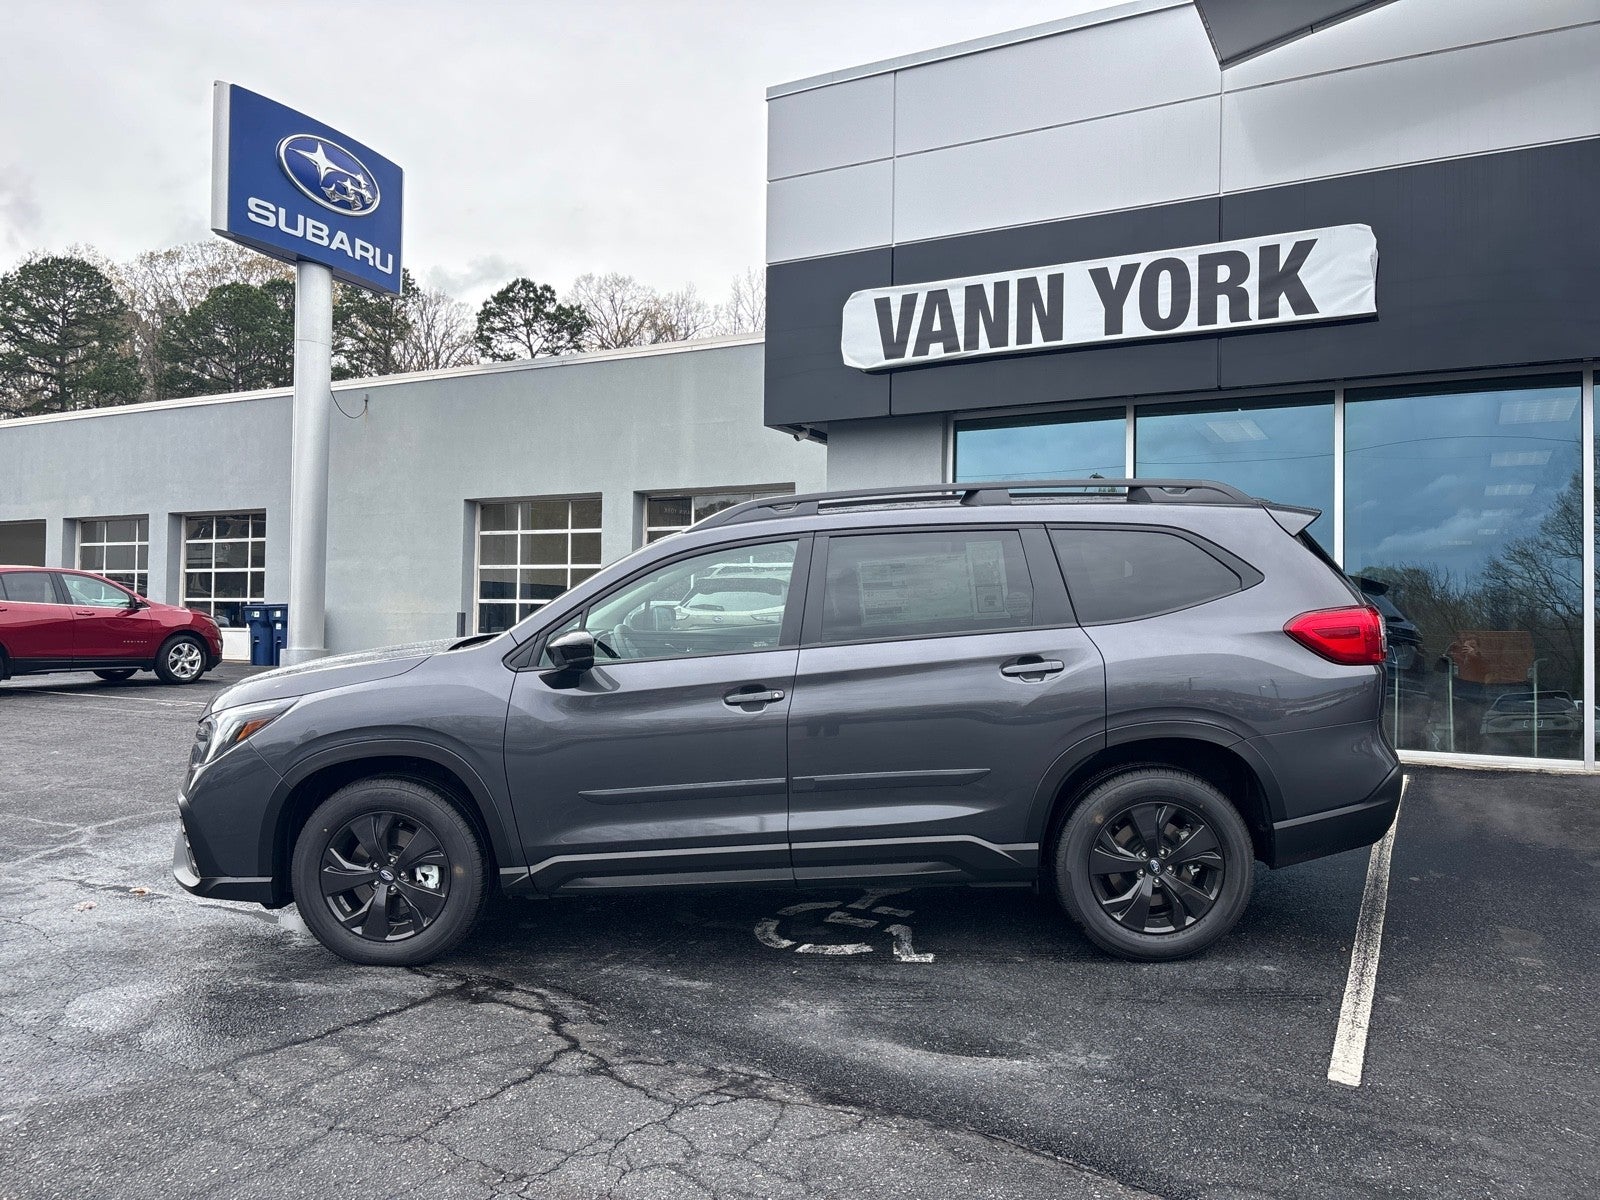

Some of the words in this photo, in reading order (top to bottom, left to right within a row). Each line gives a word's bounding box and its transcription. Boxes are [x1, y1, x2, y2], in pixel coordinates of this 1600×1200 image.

[247, 197, 393, 275] SUBARU
[873, 273, 1065, 361] VANN
[1088, 238, 1320, 336] YORK
